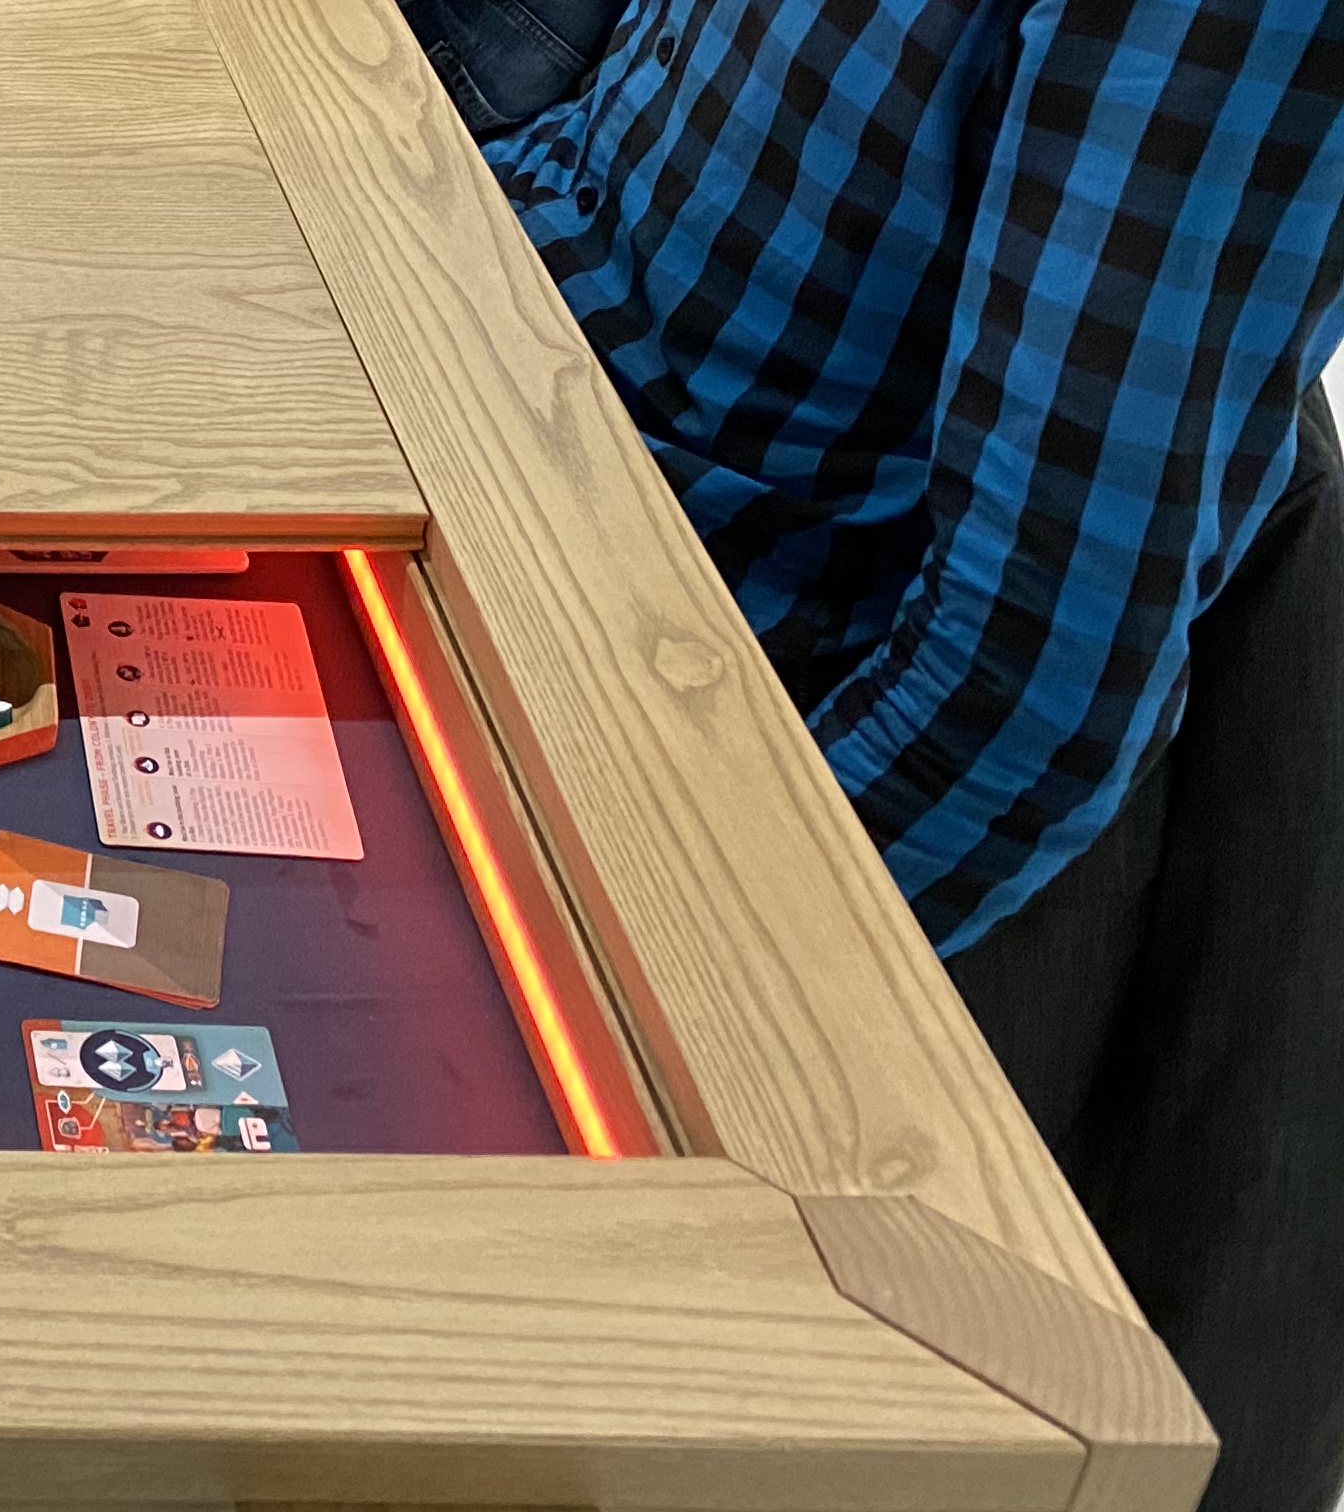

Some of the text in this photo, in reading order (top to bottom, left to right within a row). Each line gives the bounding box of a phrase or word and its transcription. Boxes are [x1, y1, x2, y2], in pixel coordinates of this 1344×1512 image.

[94, 748, 106, 771] FROM
[98, 778, 111, 805] PHASE
[103, 808, 118, 839] TRAVEL
